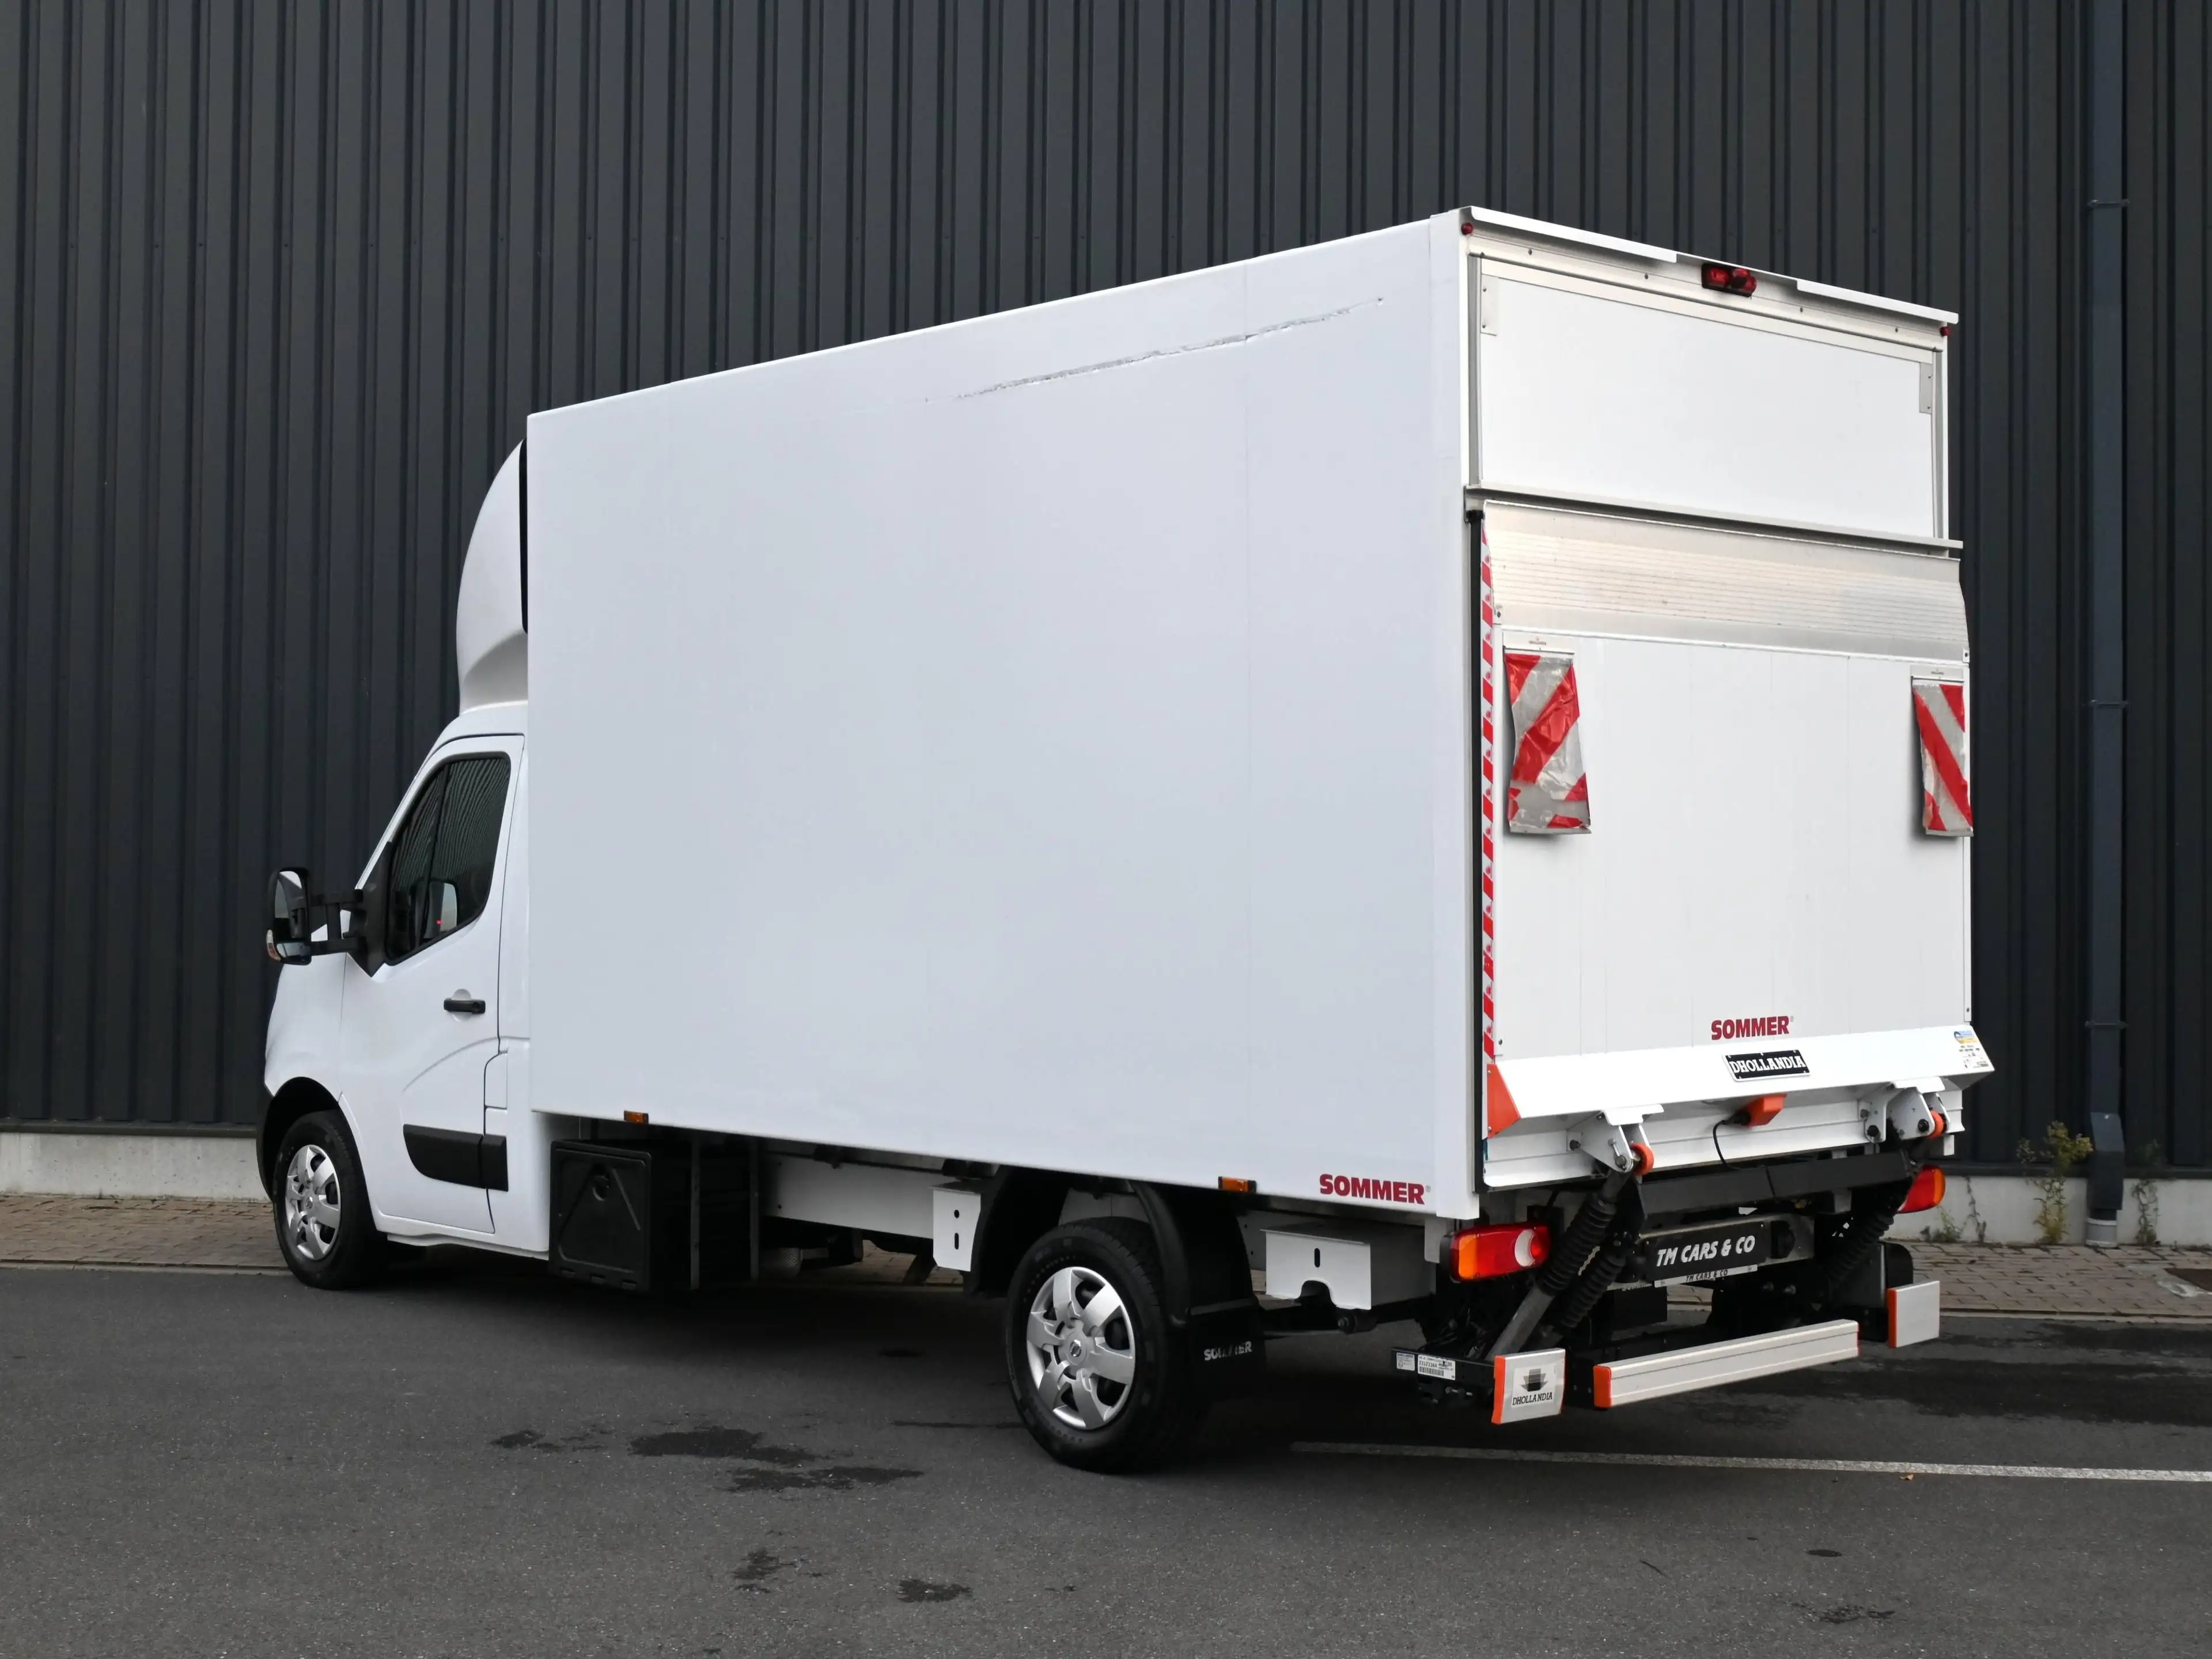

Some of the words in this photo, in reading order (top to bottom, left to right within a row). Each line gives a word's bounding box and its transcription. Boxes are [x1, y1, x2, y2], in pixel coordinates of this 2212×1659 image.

[1729, 1055, 1806, 1073] DHOLLANDIA
[1656, 1247, 1678, 1266] TM
[1681, 1241, 1718, 1263] CARS
[1721, 1239, 1732, 1256] &
[1736, 1235, 1755, 1254] CO
[1696, 1271, 1711, 1280] CARS
[1512, 1392, 1553, 1406] DHOLLANDIA
